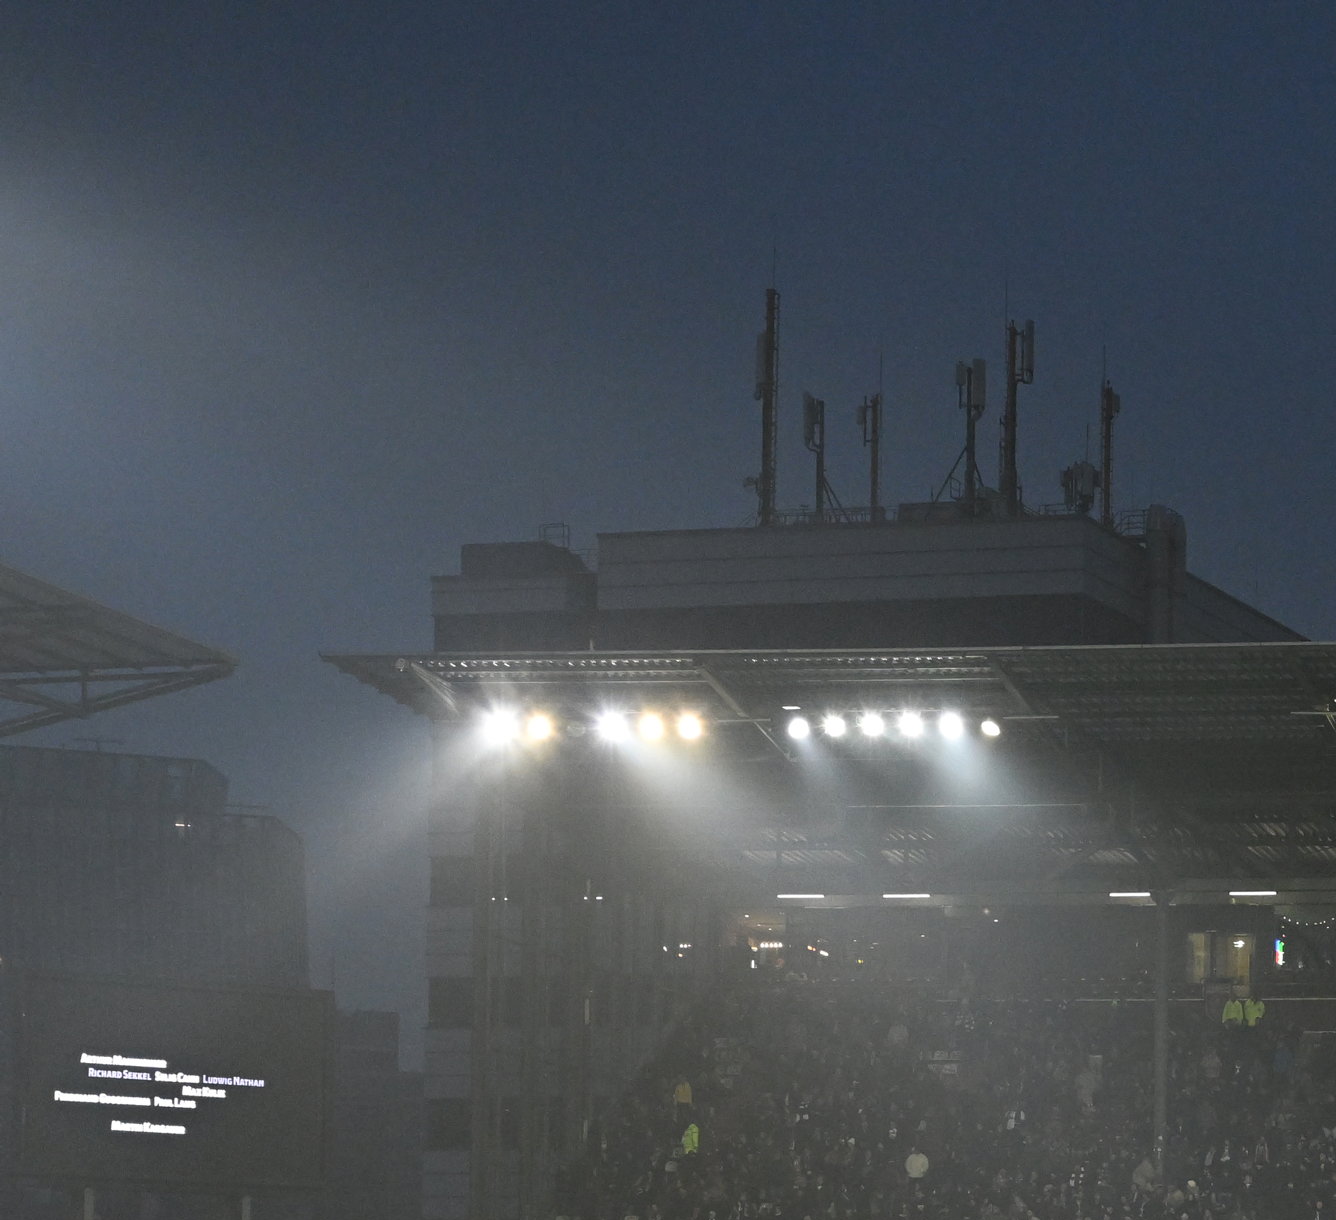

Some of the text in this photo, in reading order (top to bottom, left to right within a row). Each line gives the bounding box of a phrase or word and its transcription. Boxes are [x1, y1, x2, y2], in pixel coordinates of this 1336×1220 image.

[88, 1067, 122, 1079] RICHARD
[123, 1069, 151, 1081] SEKKEL
[203, 1074, 232, 1086] LUDWIG
[233, 1076, 264, 1087] NATHAN
